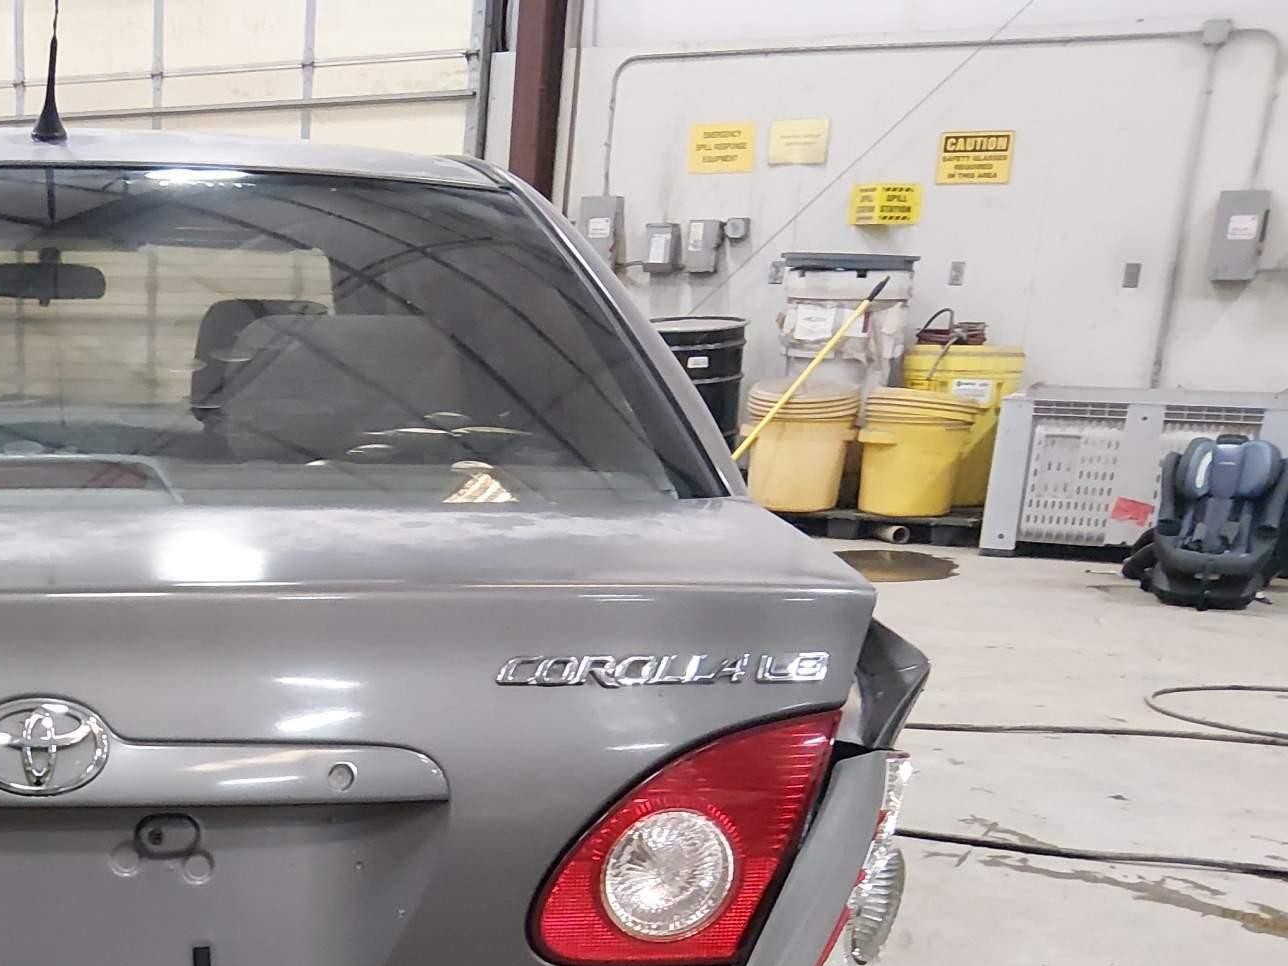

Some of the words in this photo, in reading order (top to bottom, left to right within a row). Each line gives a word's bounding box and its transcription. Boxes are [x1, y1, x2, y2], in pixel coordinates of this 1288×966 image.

[945, 136, 1009, 152] CAUTION
[886, 194, 908, 203] SPILL
[880, 205, 912, 213] STATION
[496, 652, 751, 688] COROLLA
[755, 651, 830, 684] LE
